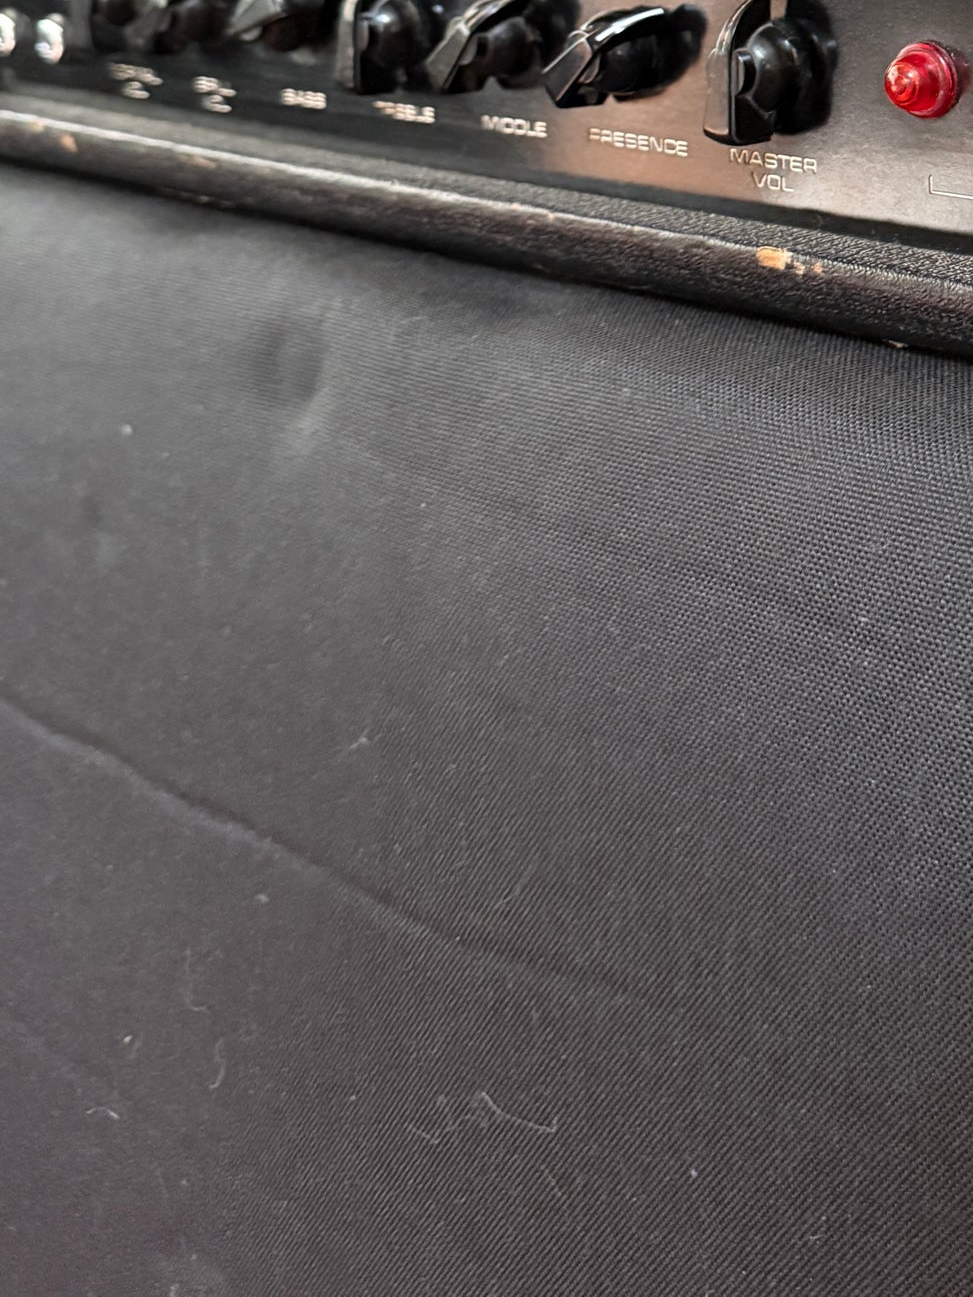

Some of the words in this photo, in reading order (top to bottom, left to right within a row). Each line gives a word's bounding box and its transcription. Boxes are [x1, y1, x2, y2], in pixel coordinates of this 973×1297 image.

[480, 114, 548, 138] MIDDLE
[588, 127, 688, 157] PRESENCE
[729, 147, 818, 174] MASTER
[752, 171, 795, 192] VOL
